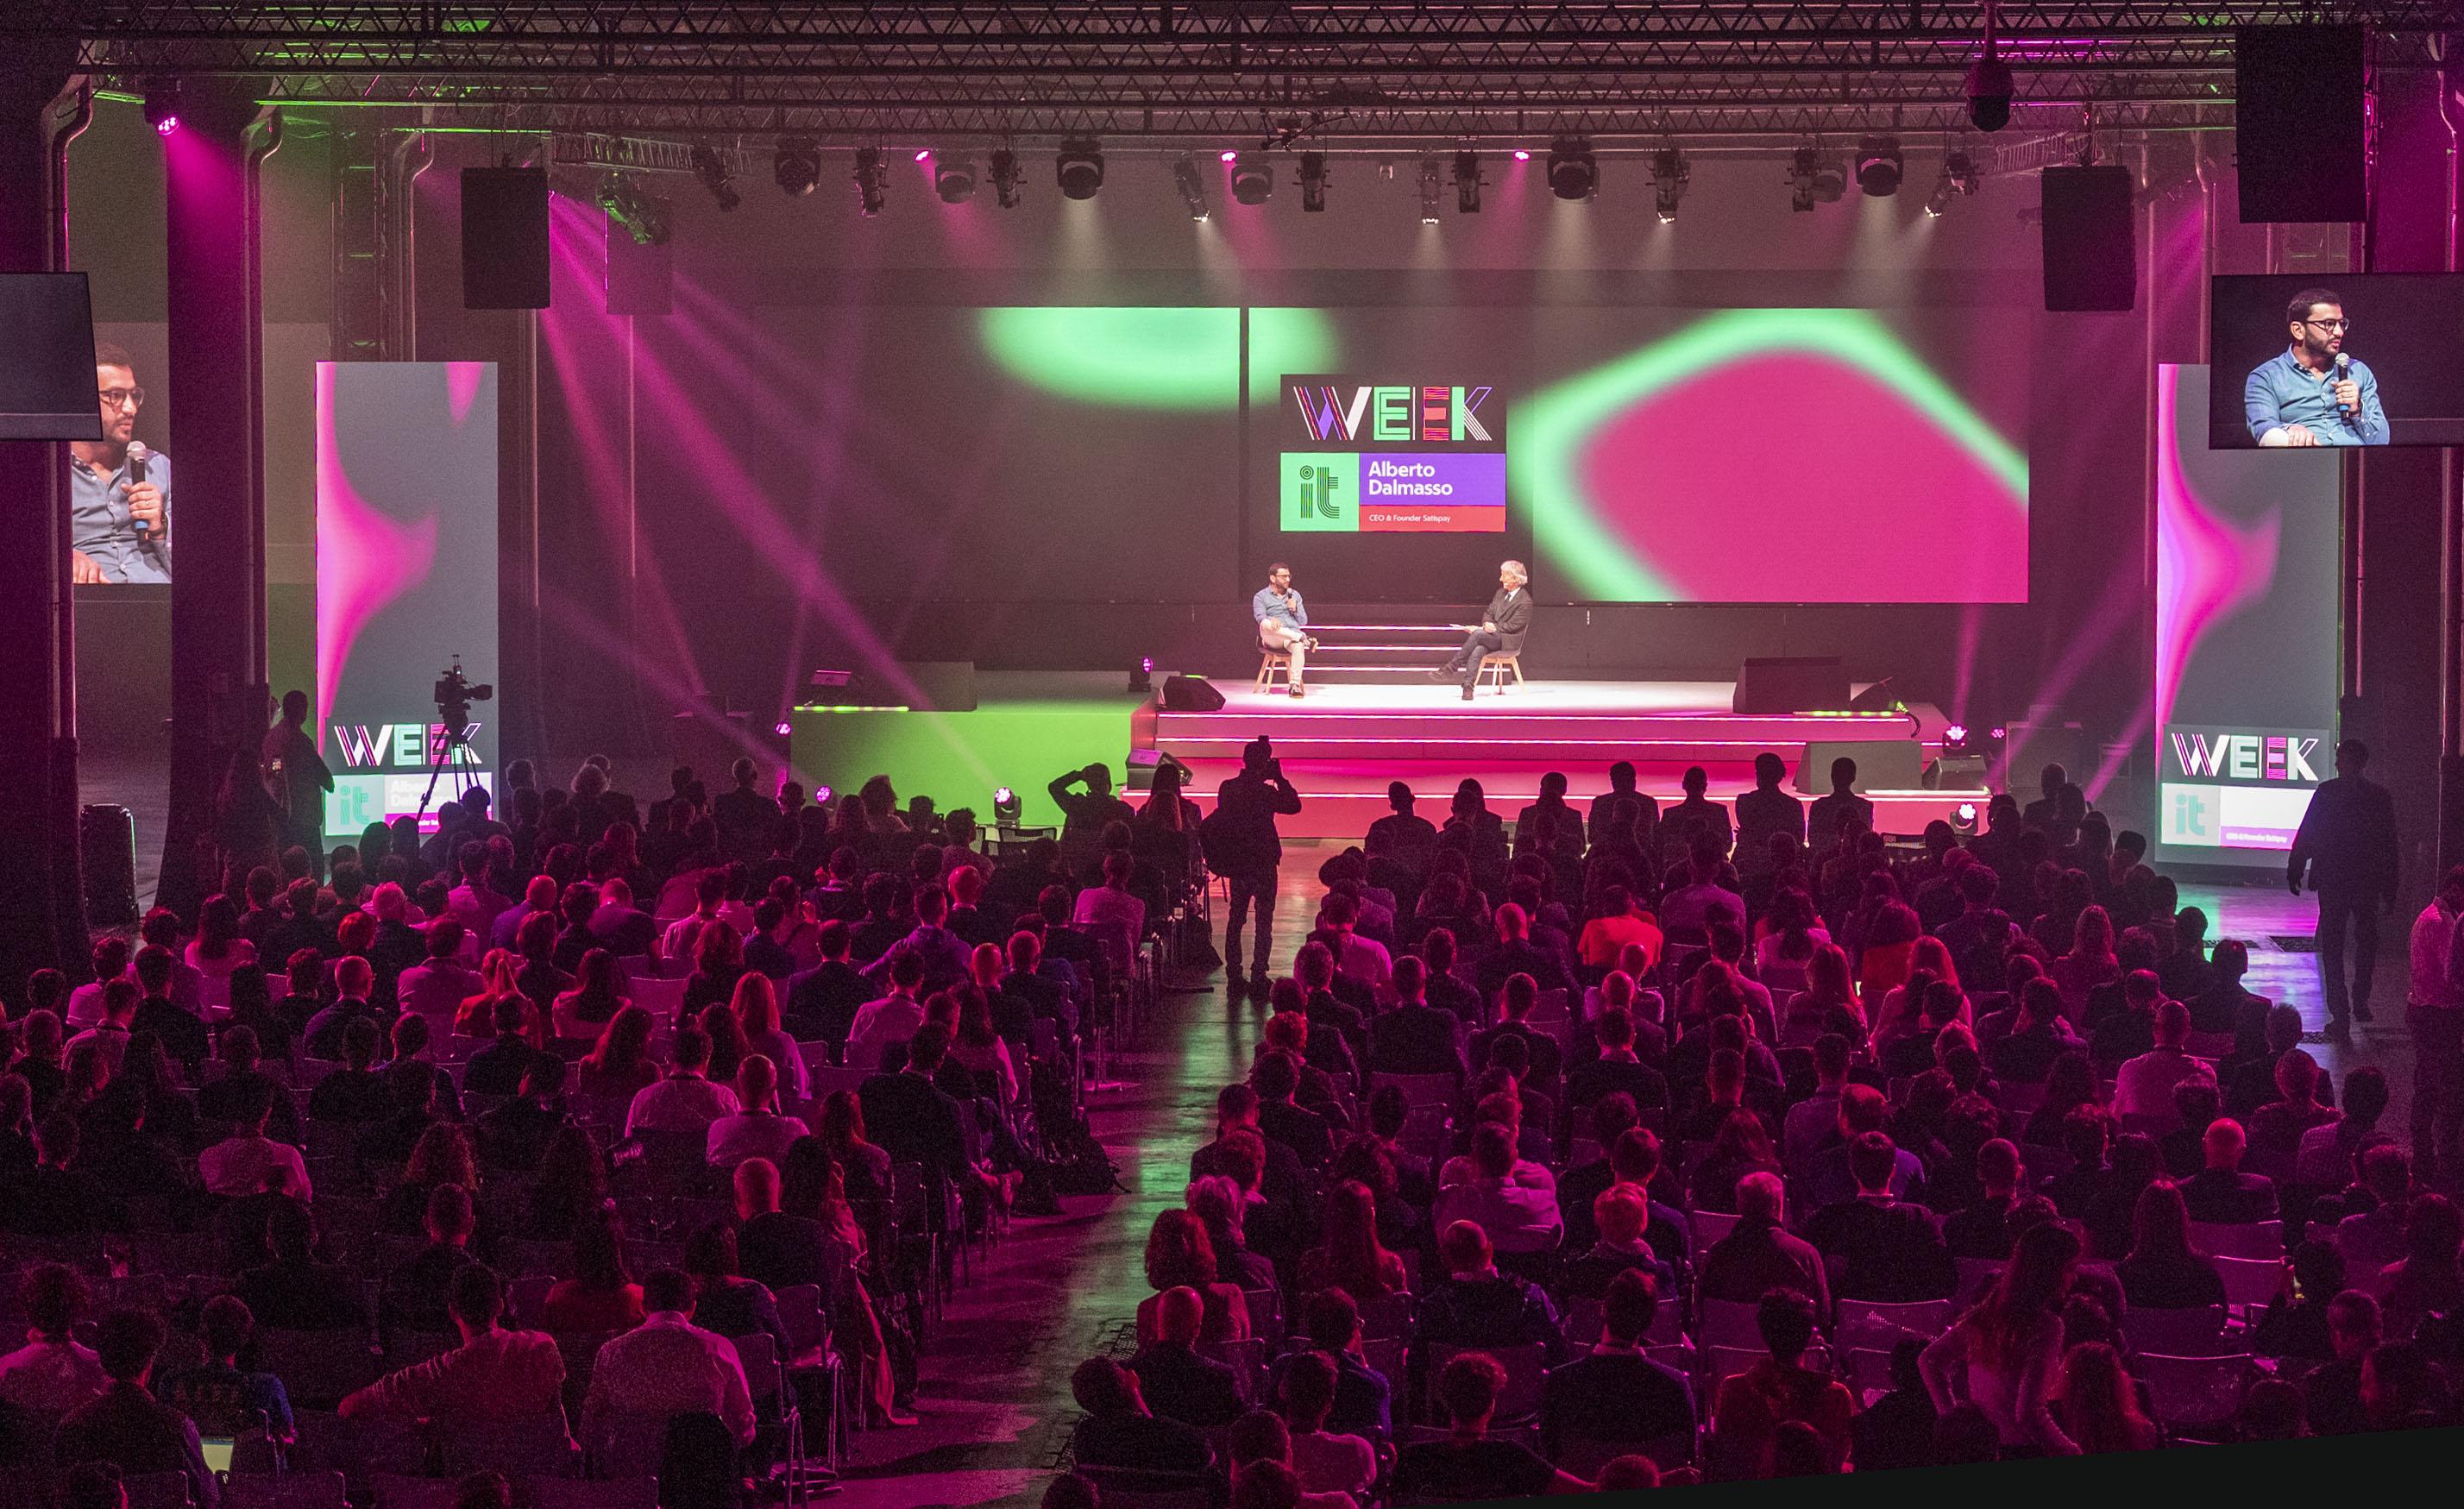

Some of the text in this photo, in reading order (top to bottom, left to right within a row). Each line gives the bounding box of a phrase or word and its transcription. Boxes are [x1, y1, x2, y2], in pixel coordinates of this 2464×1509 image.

[1293, 386, 1493, 441] WEEK
[1368, 461, 1436, 477] Alberto
[1368, 479, 1453, 495] Dalmasso
[1299, 465, 1340, 519] it
[2171, 732, 2319, 781] WEEK
[340, 785, 370, 825] it
[2175, 793, 2206, 836] it
